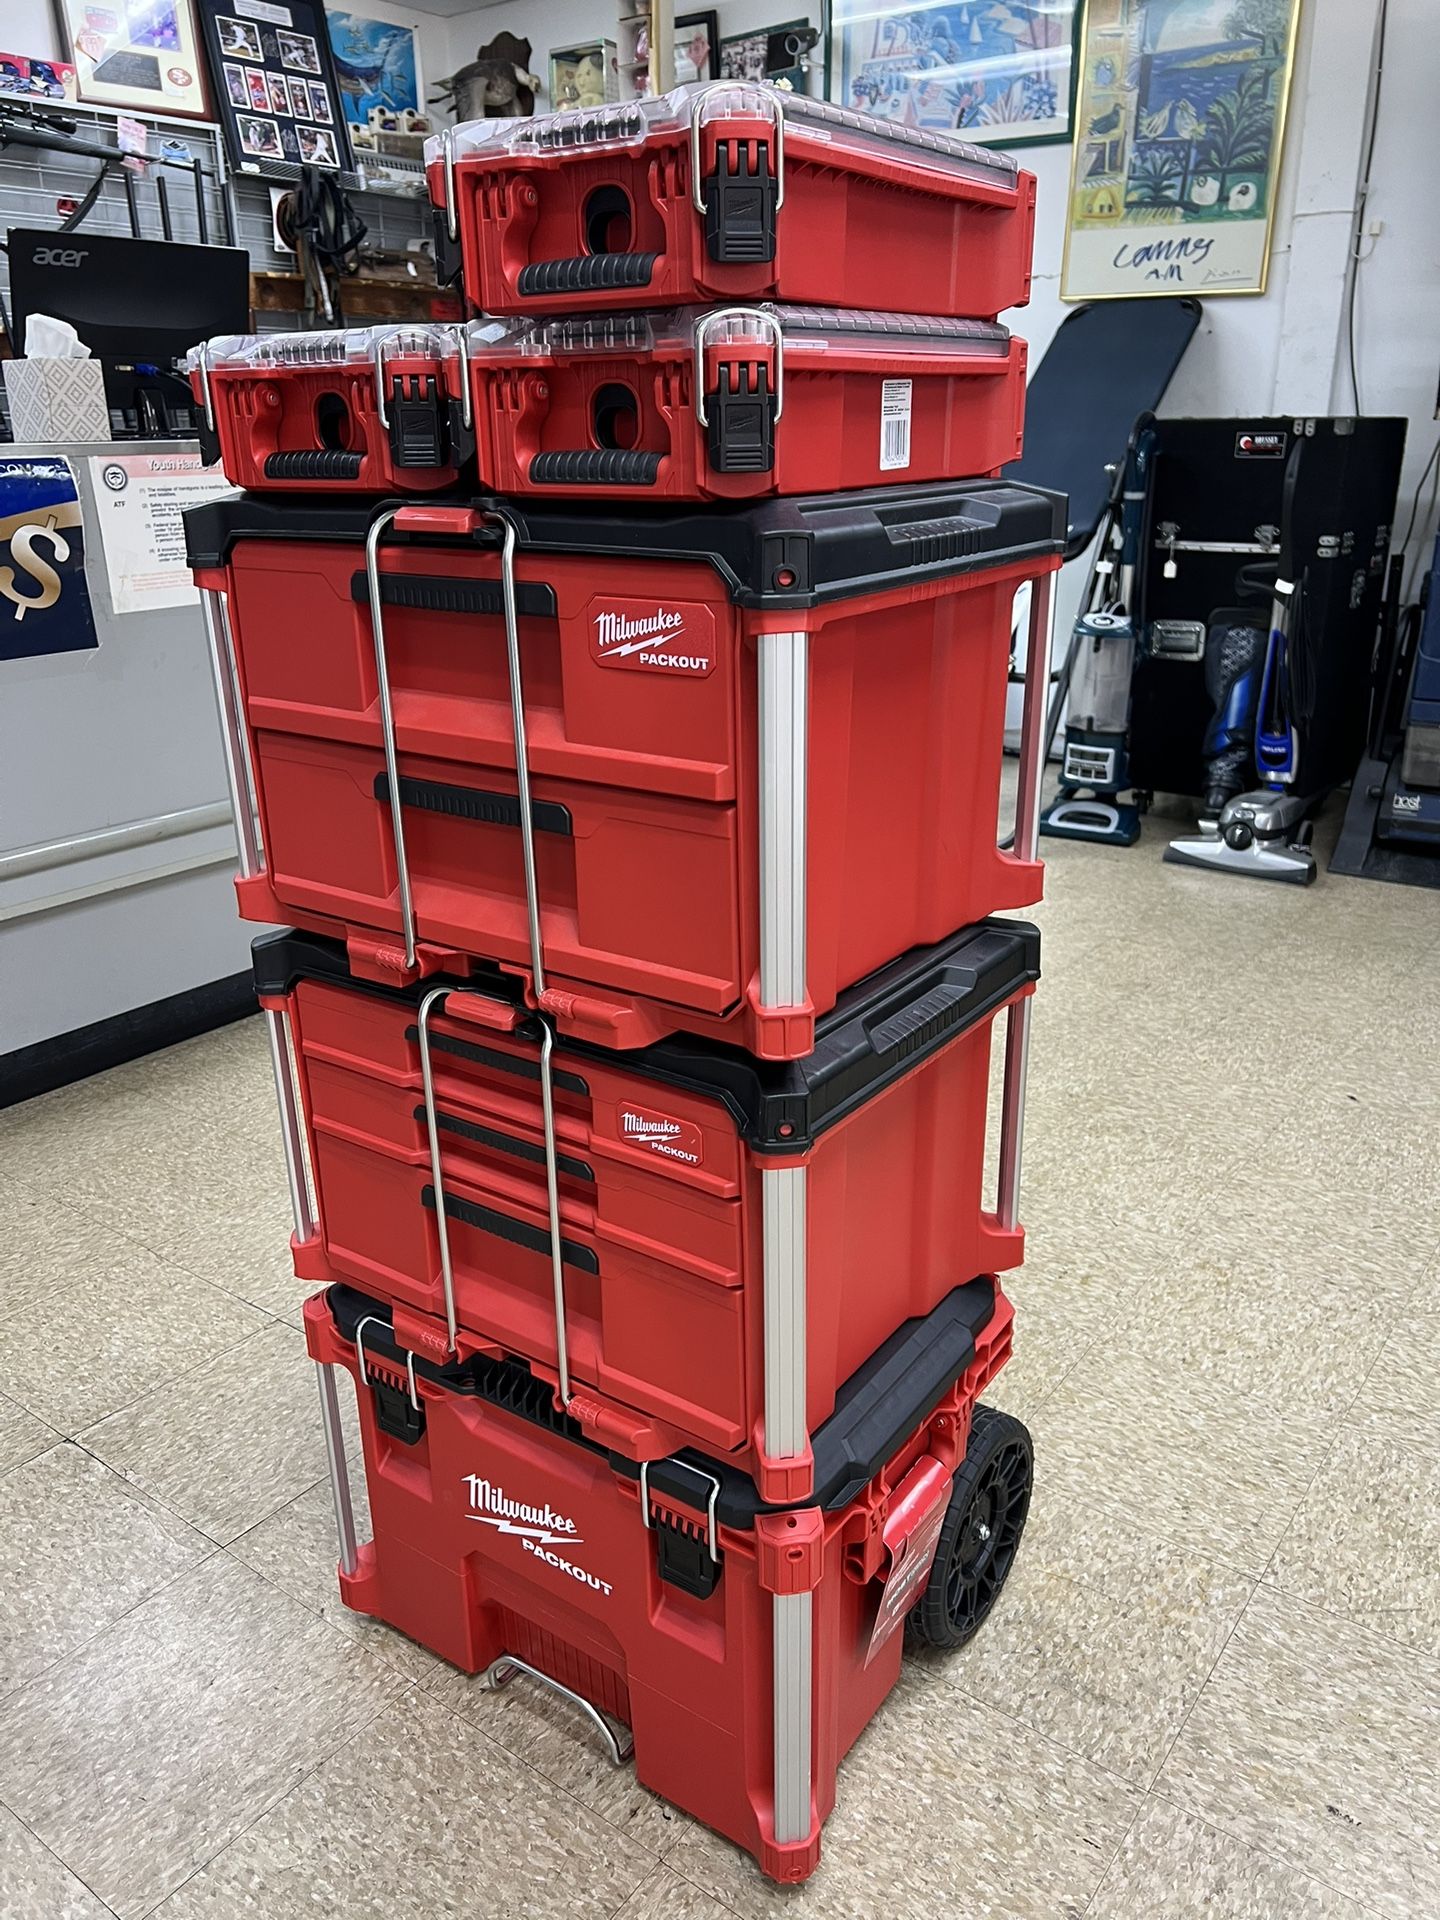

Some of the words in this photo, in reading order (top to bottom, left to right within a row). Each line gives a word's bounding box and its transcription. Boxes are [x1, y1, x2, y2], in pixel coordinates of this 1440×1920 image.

[32, 247, 89, 268] acer
[592, 607, 684, 648] Milwaukee
[639, 652, 709, 671] PACKOUT
[620, 1111, 682, 1134] Milwaukee
[651, 1141, 699, 1164] PACKOUT
[460, 1472, 578, 1534] Milwaukee
[521, 1537, 613, 1596] PACKOUT
